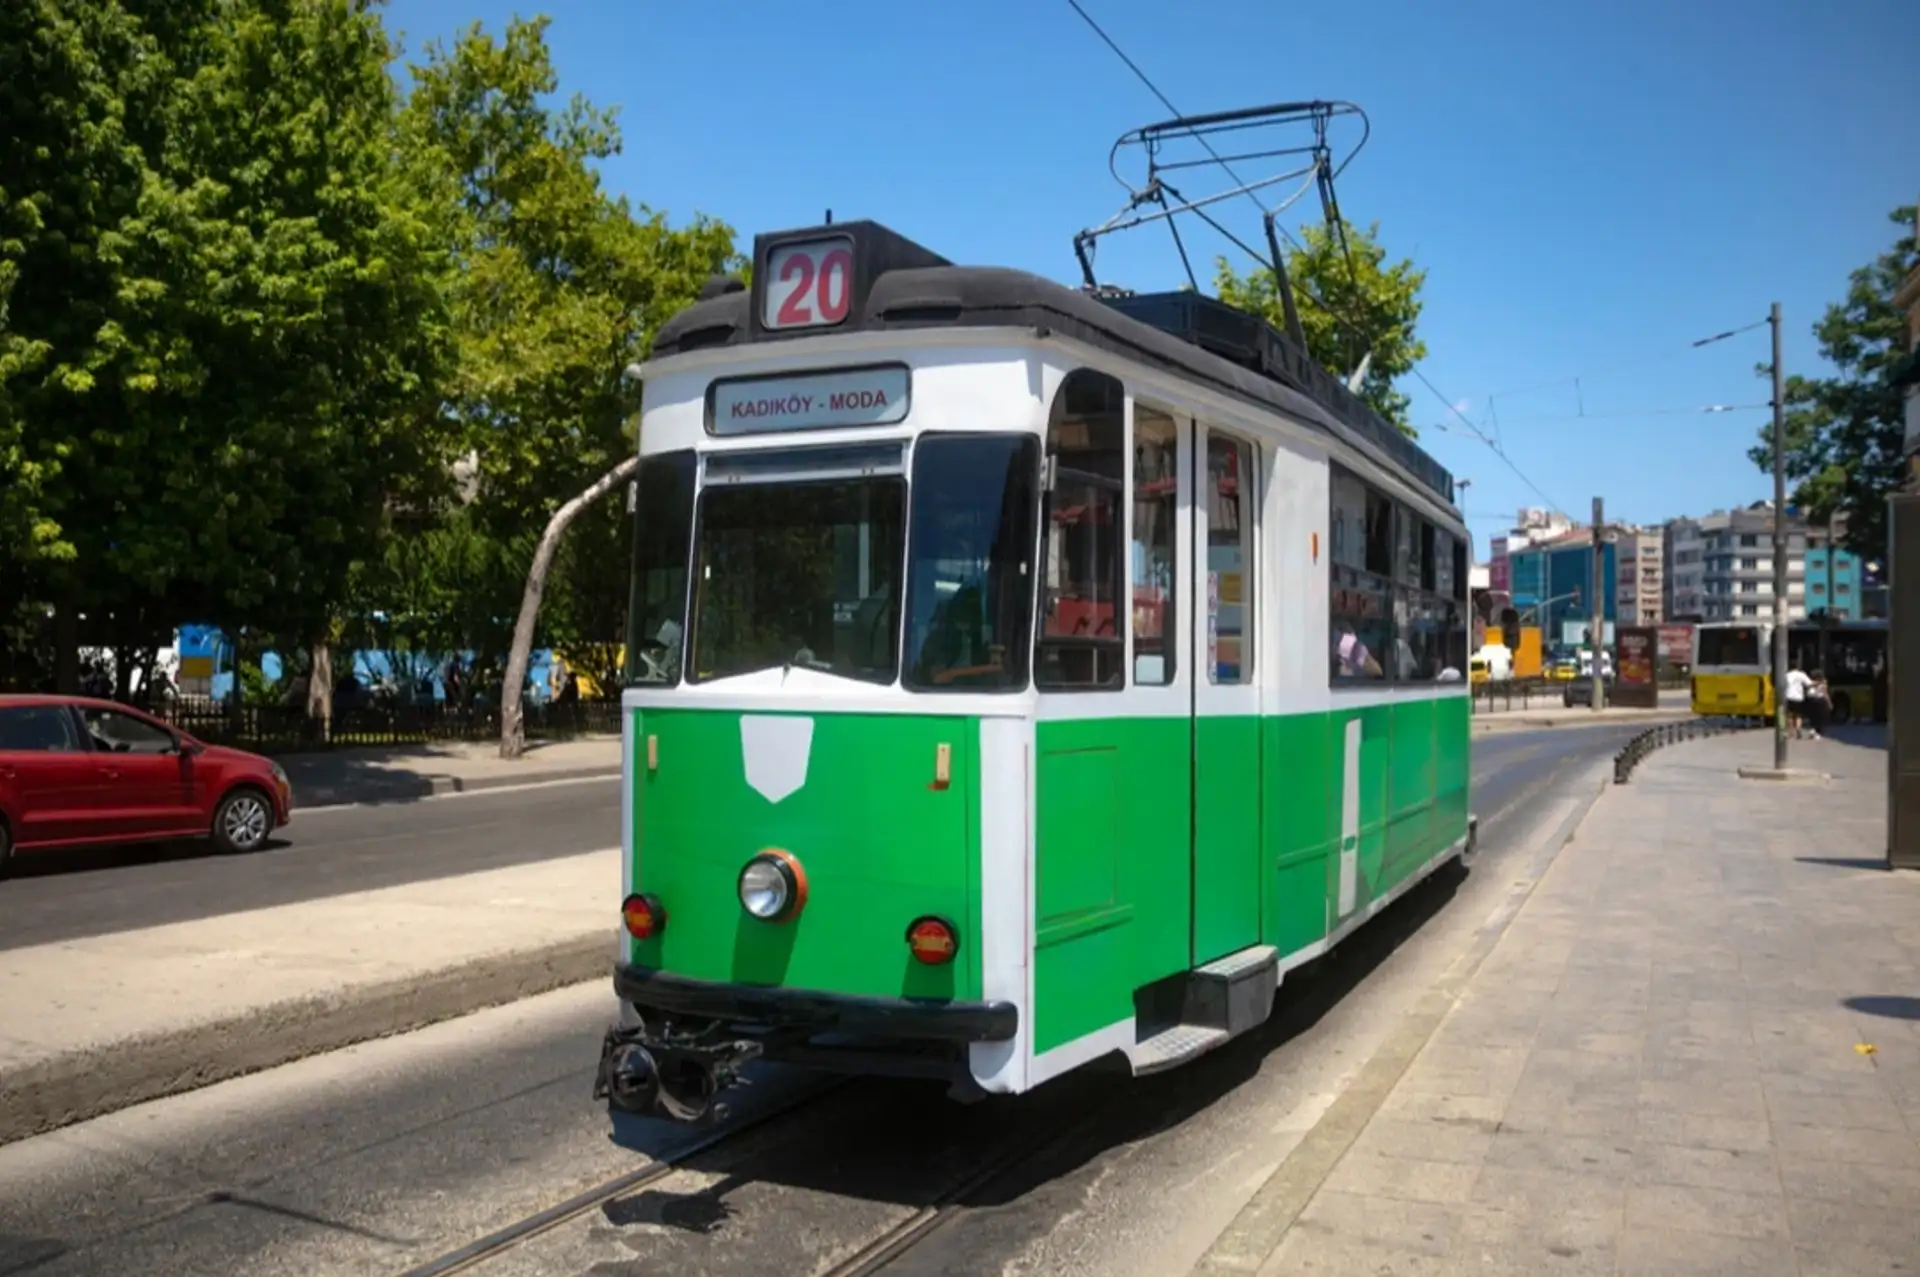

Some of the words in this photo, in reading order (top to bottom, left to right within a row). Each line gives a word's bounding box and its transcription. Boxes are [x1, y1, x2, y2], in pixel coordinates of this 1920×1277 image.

[777, 250, 851, 325] 20
[731, 393, 813, 418] KADIKÖY
[829, 390, 887, 412] MODA
